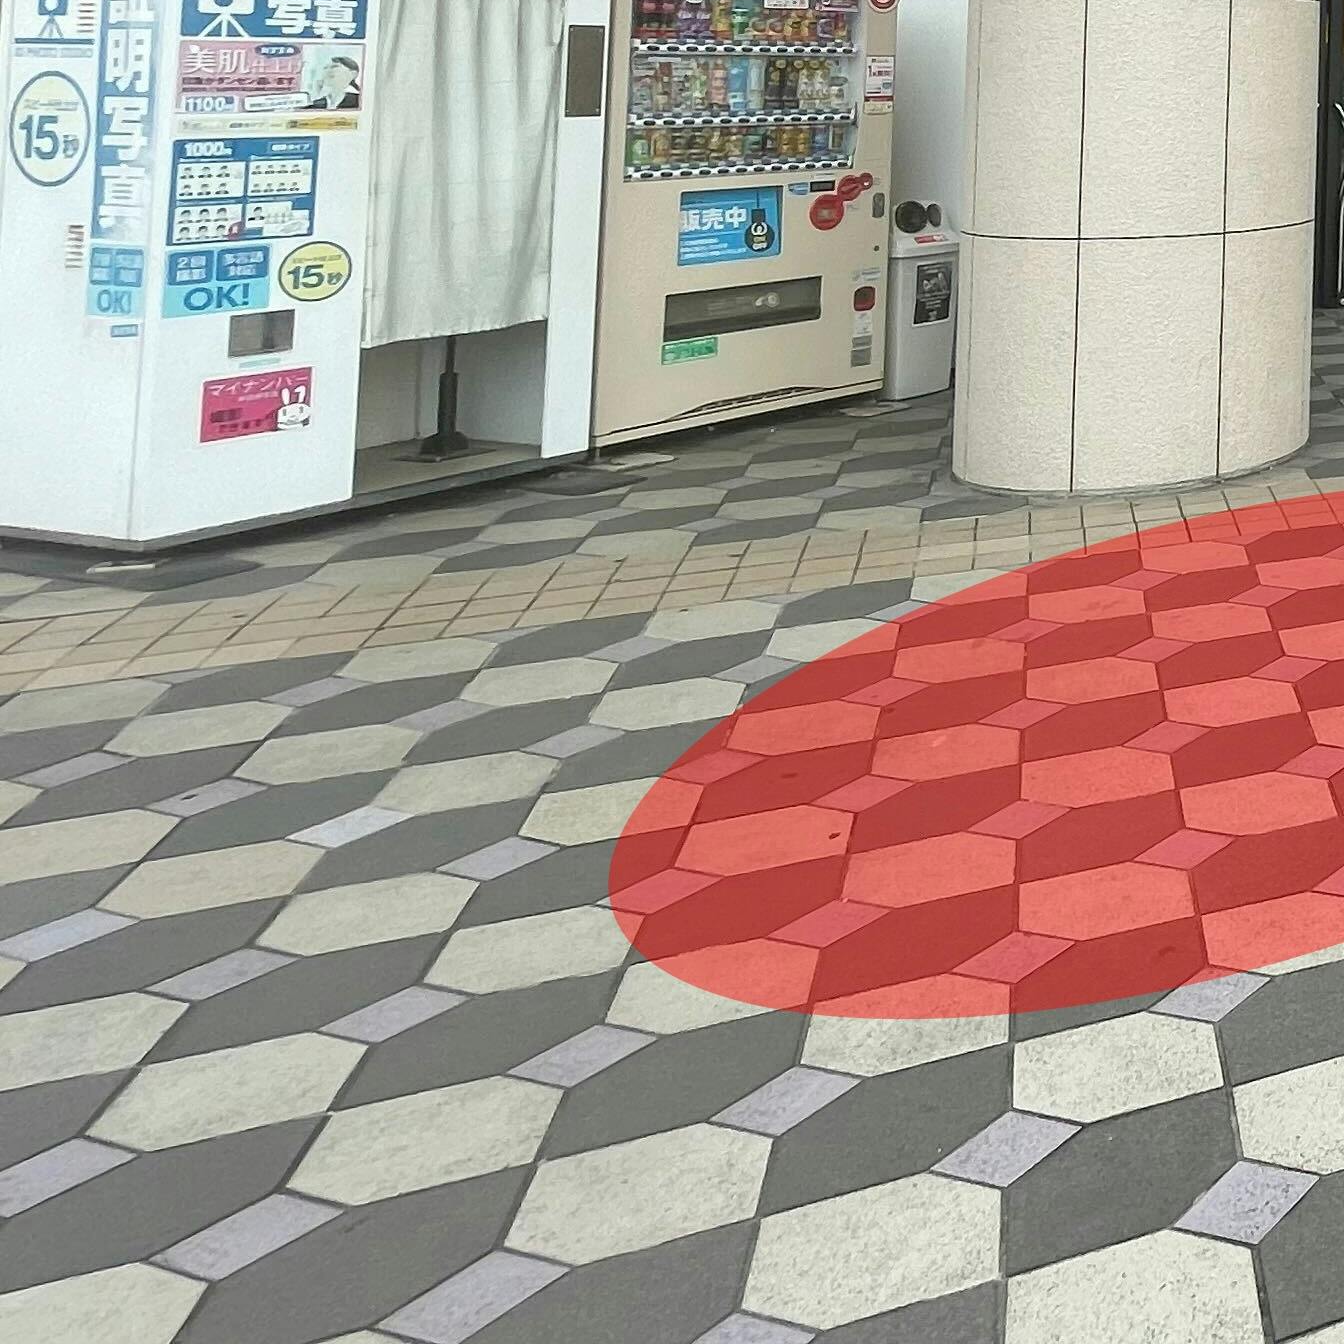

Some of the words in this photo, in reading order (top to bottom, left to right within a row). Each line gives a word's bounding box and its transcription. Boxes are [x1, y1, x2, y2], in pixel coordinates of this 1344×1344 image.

[183, 283, 250, 311] OK!
[208, 376, 308, 397] マイナンバー
